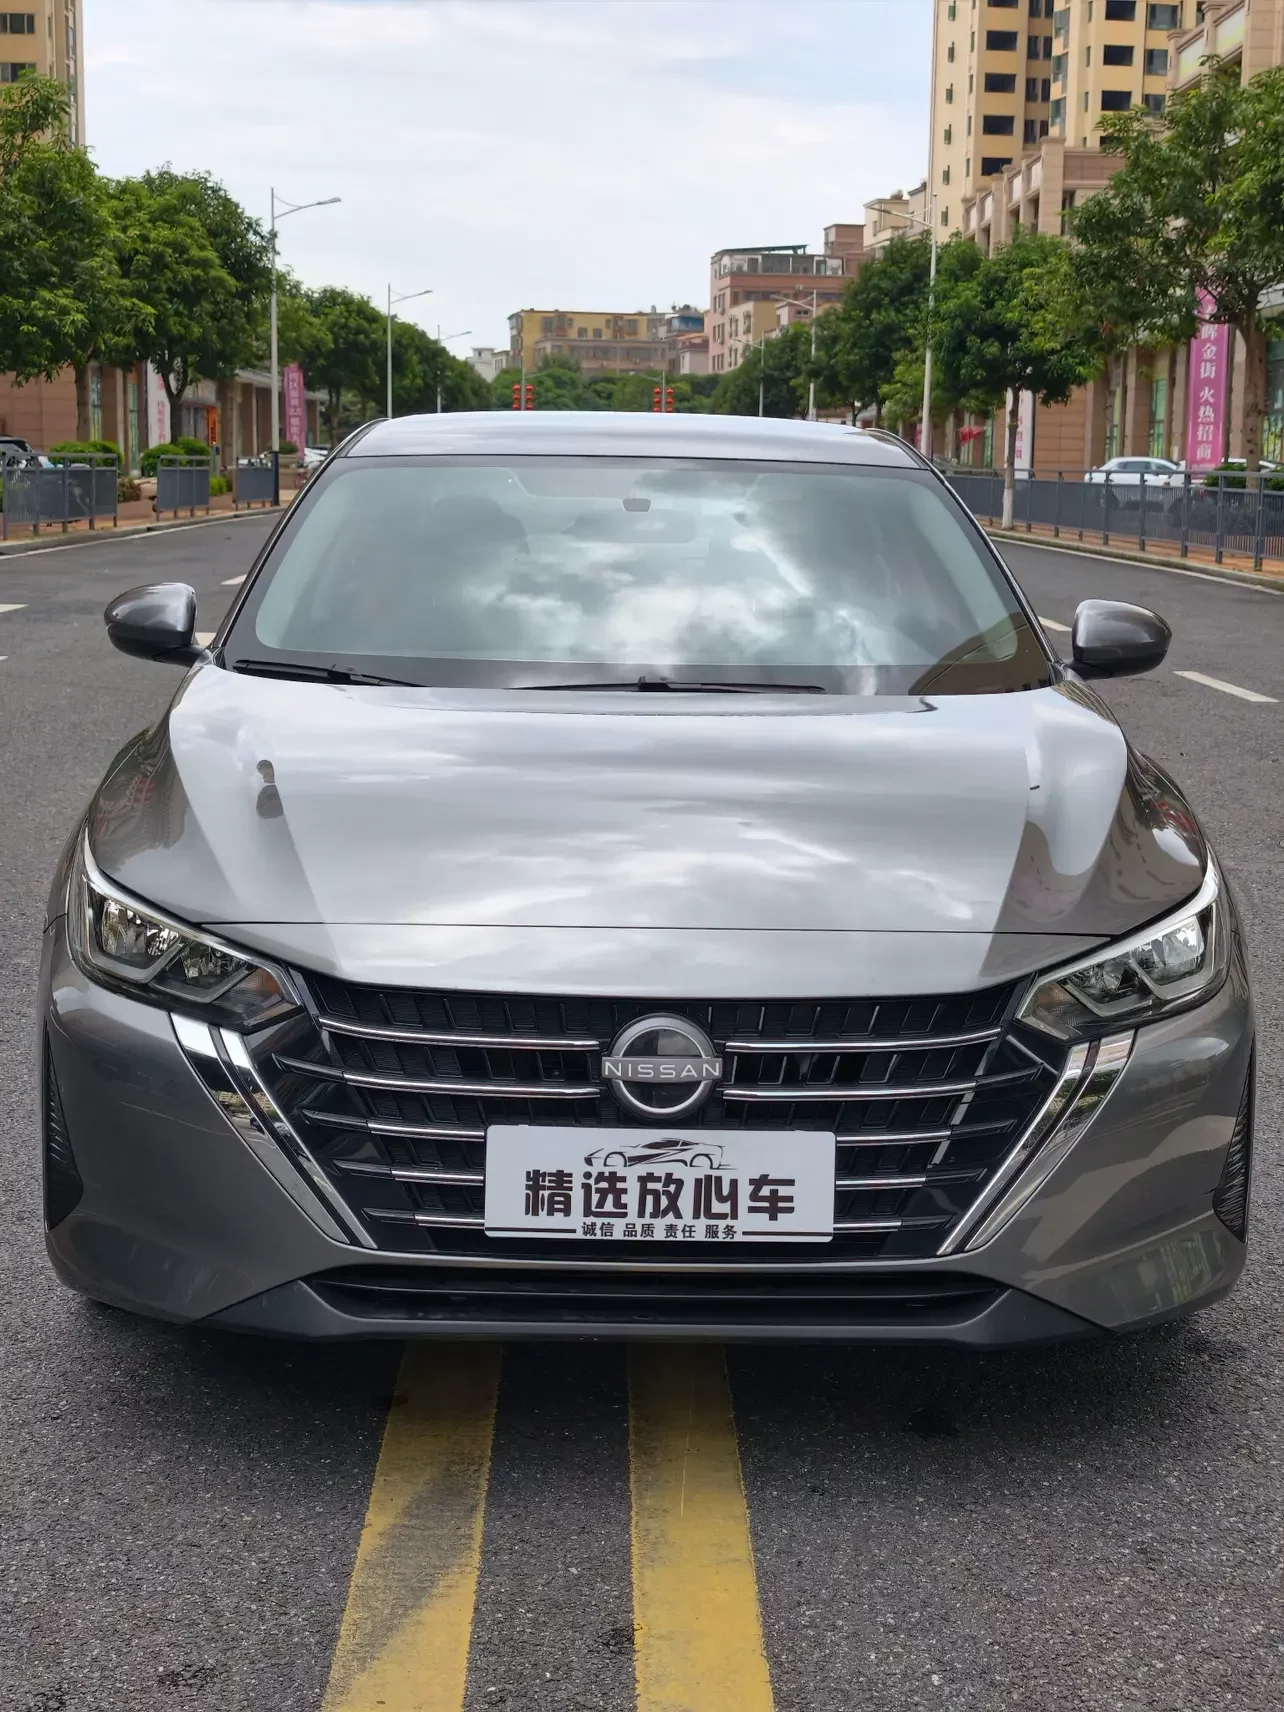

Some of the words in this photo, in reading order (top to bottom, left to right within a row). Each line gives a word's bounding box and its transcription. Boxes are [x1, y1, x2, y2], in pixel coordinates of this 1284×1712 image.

[1196, 386, 1215, 460] 火热招商
[603, 1060, 720, 1079] NISSAN
[525, 1169, 796, 1222] 精选放心车
[581, 1222, 615, 1238] 诚信
[623, 1223, 655, 1238] 品质
[664, 1224, 696, 1239] 责任
[704, 1225, 738, 1239] 服务
